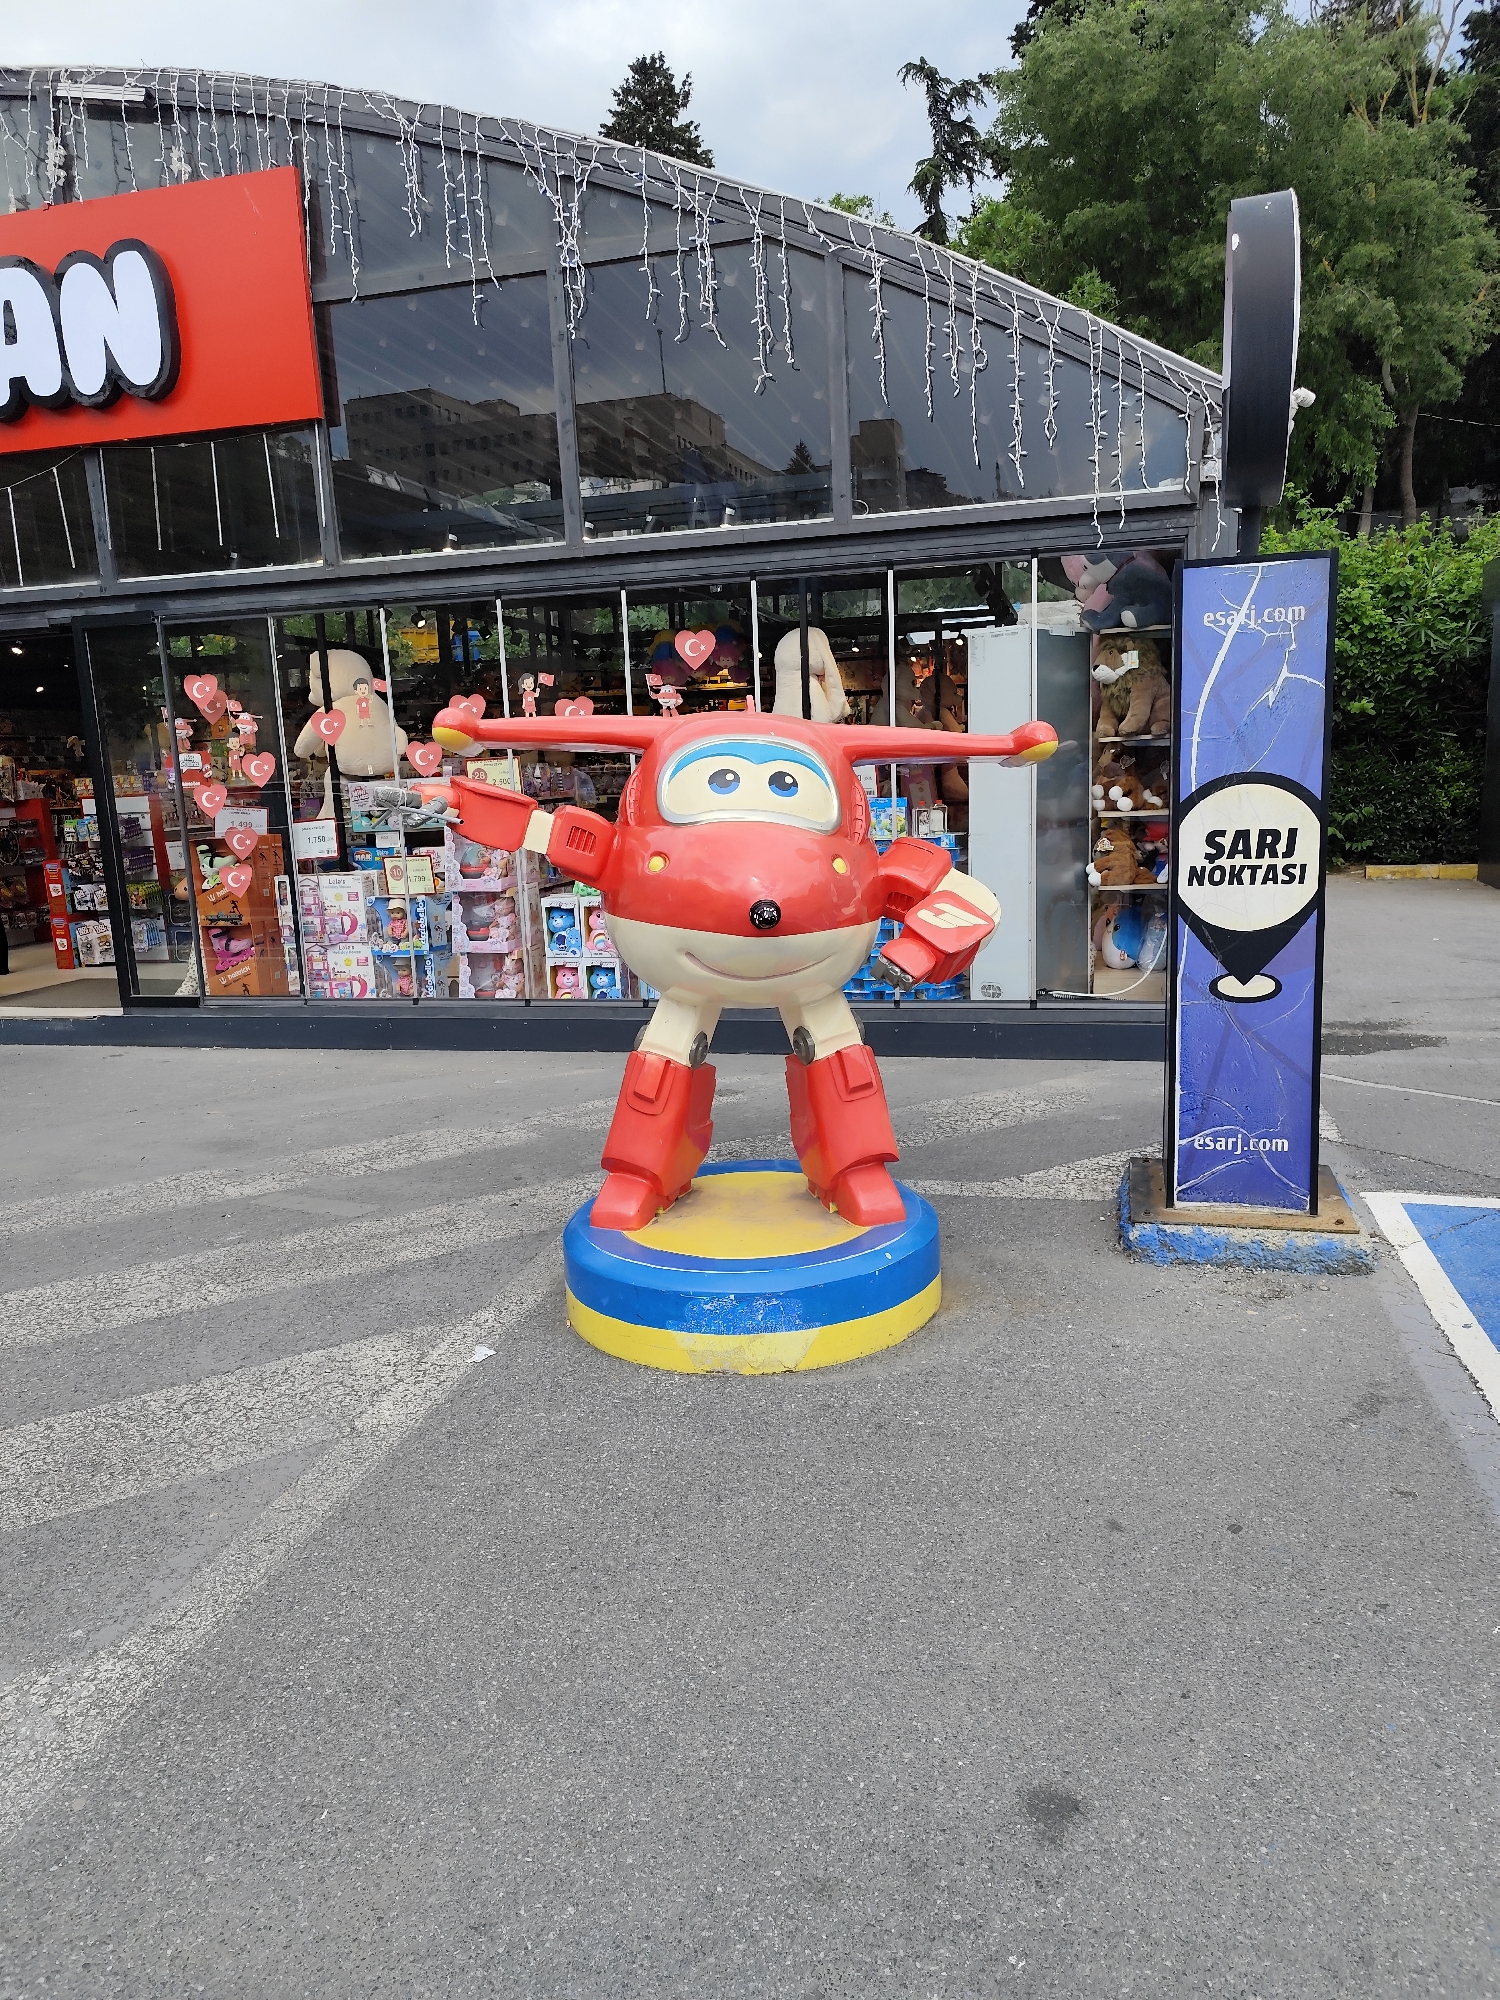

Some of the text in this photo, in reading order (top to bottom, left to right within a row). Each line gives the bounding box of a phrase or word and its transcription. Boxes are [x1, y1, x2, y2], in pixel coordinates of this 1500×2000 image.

[1203, 604, 1306, 629] esarj.com
[1203, 827, 1299, 864] ŞARJ
[1187, 863, 1308, 886] NOKTASI
[1194, 1133, 1289, 1155] esarj.com
